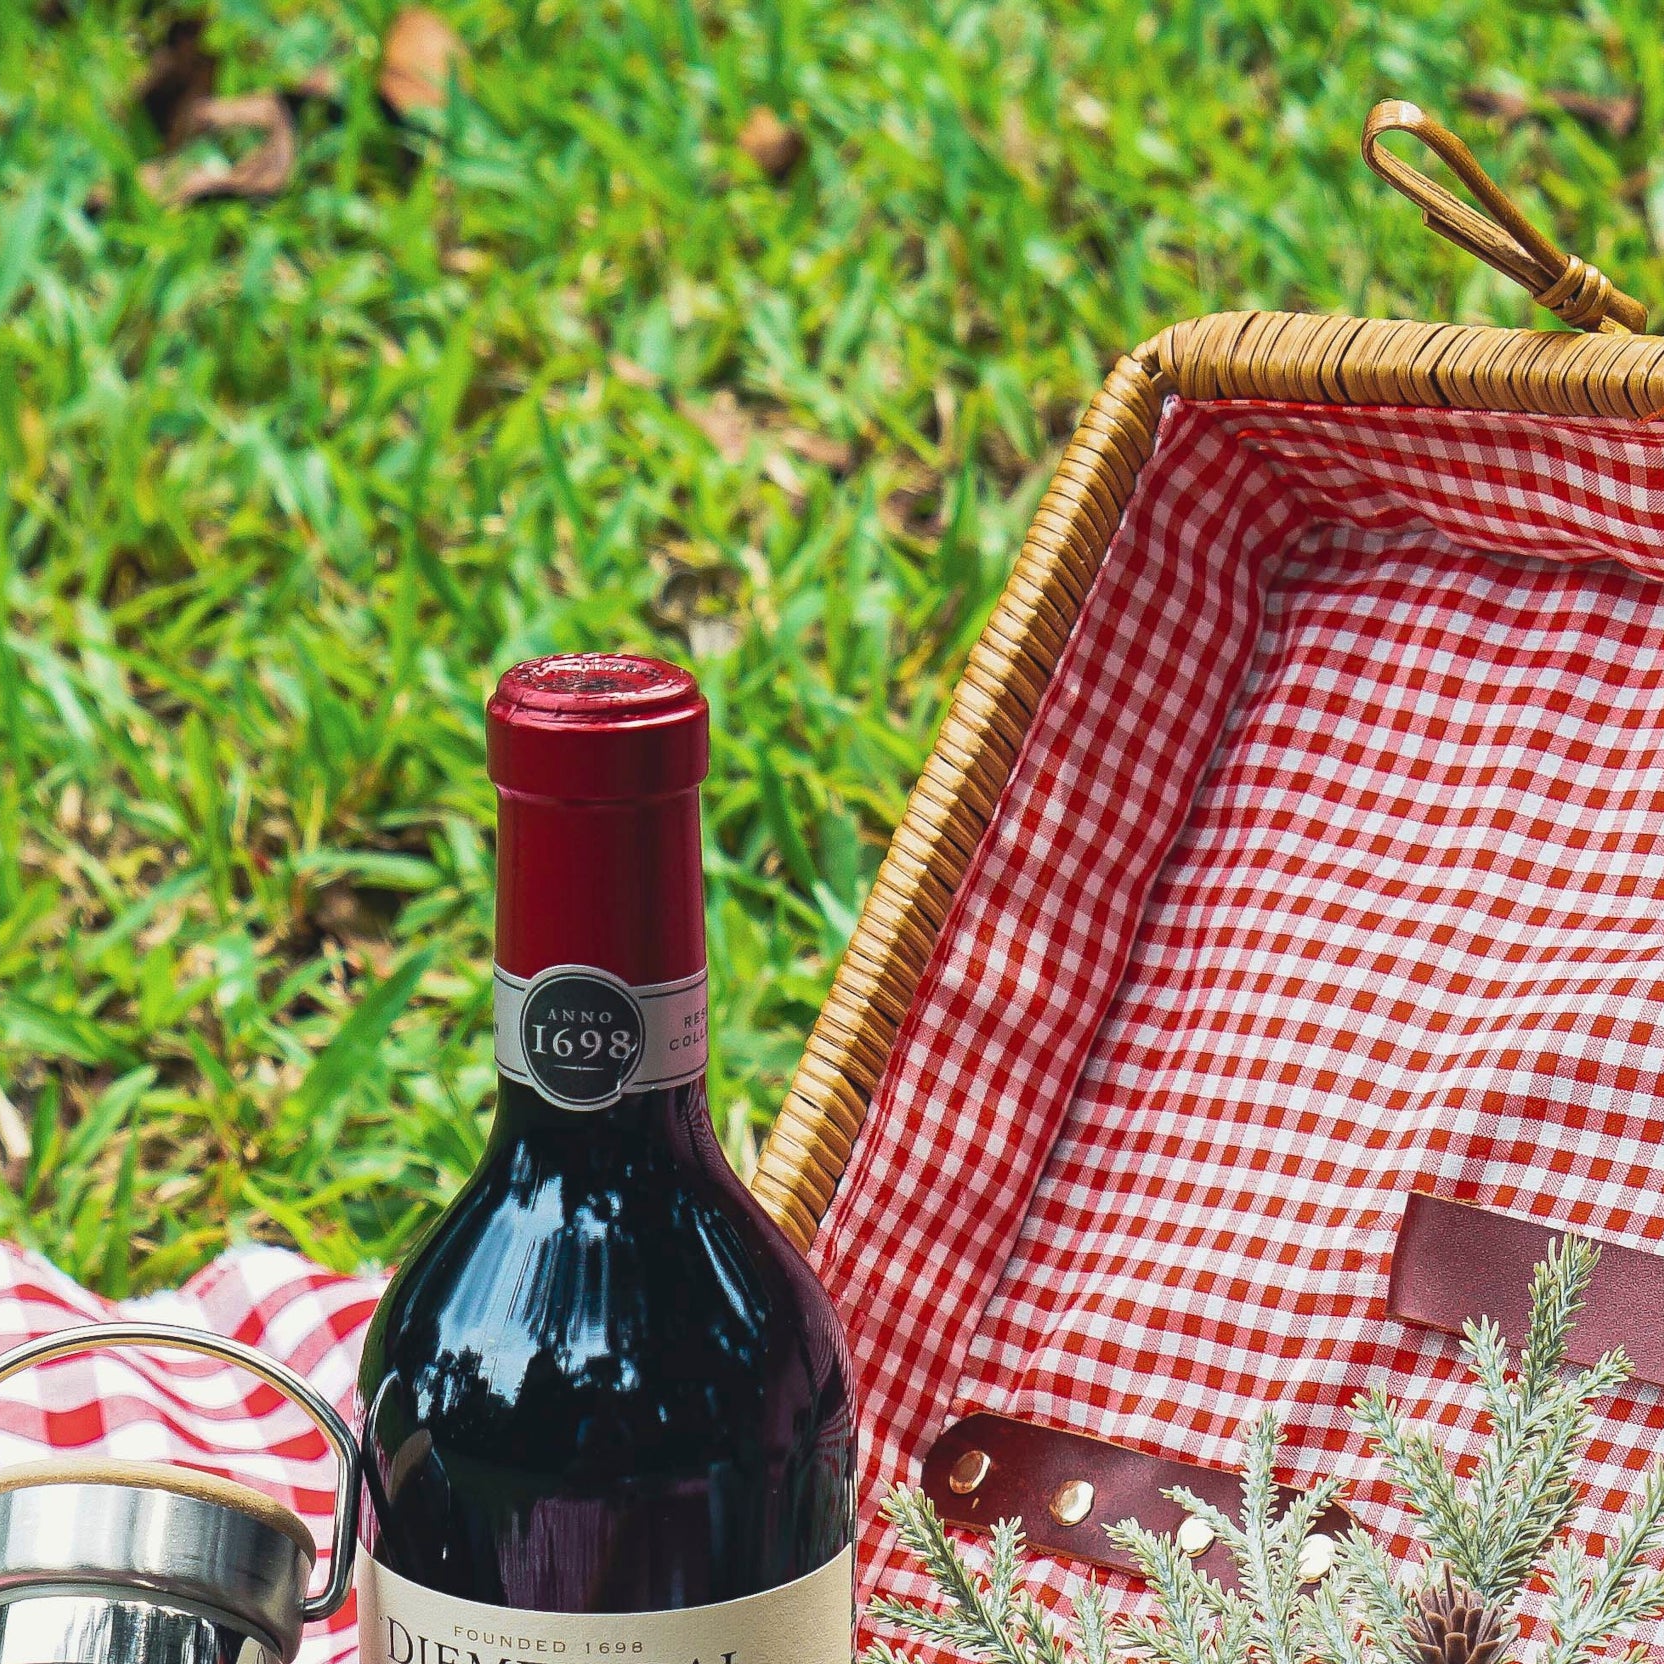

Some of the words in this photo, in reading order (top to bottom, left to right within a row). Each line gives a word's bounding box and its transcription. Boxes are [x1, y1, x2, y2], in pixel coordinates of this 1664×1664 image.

[546, 1008, 613, 1024] ANNO
[531, 1024, 632, 1060] 1698
[454, 1626, 566, 1653] FOUNDED
[585, 1641, 644, 1655] 1698
